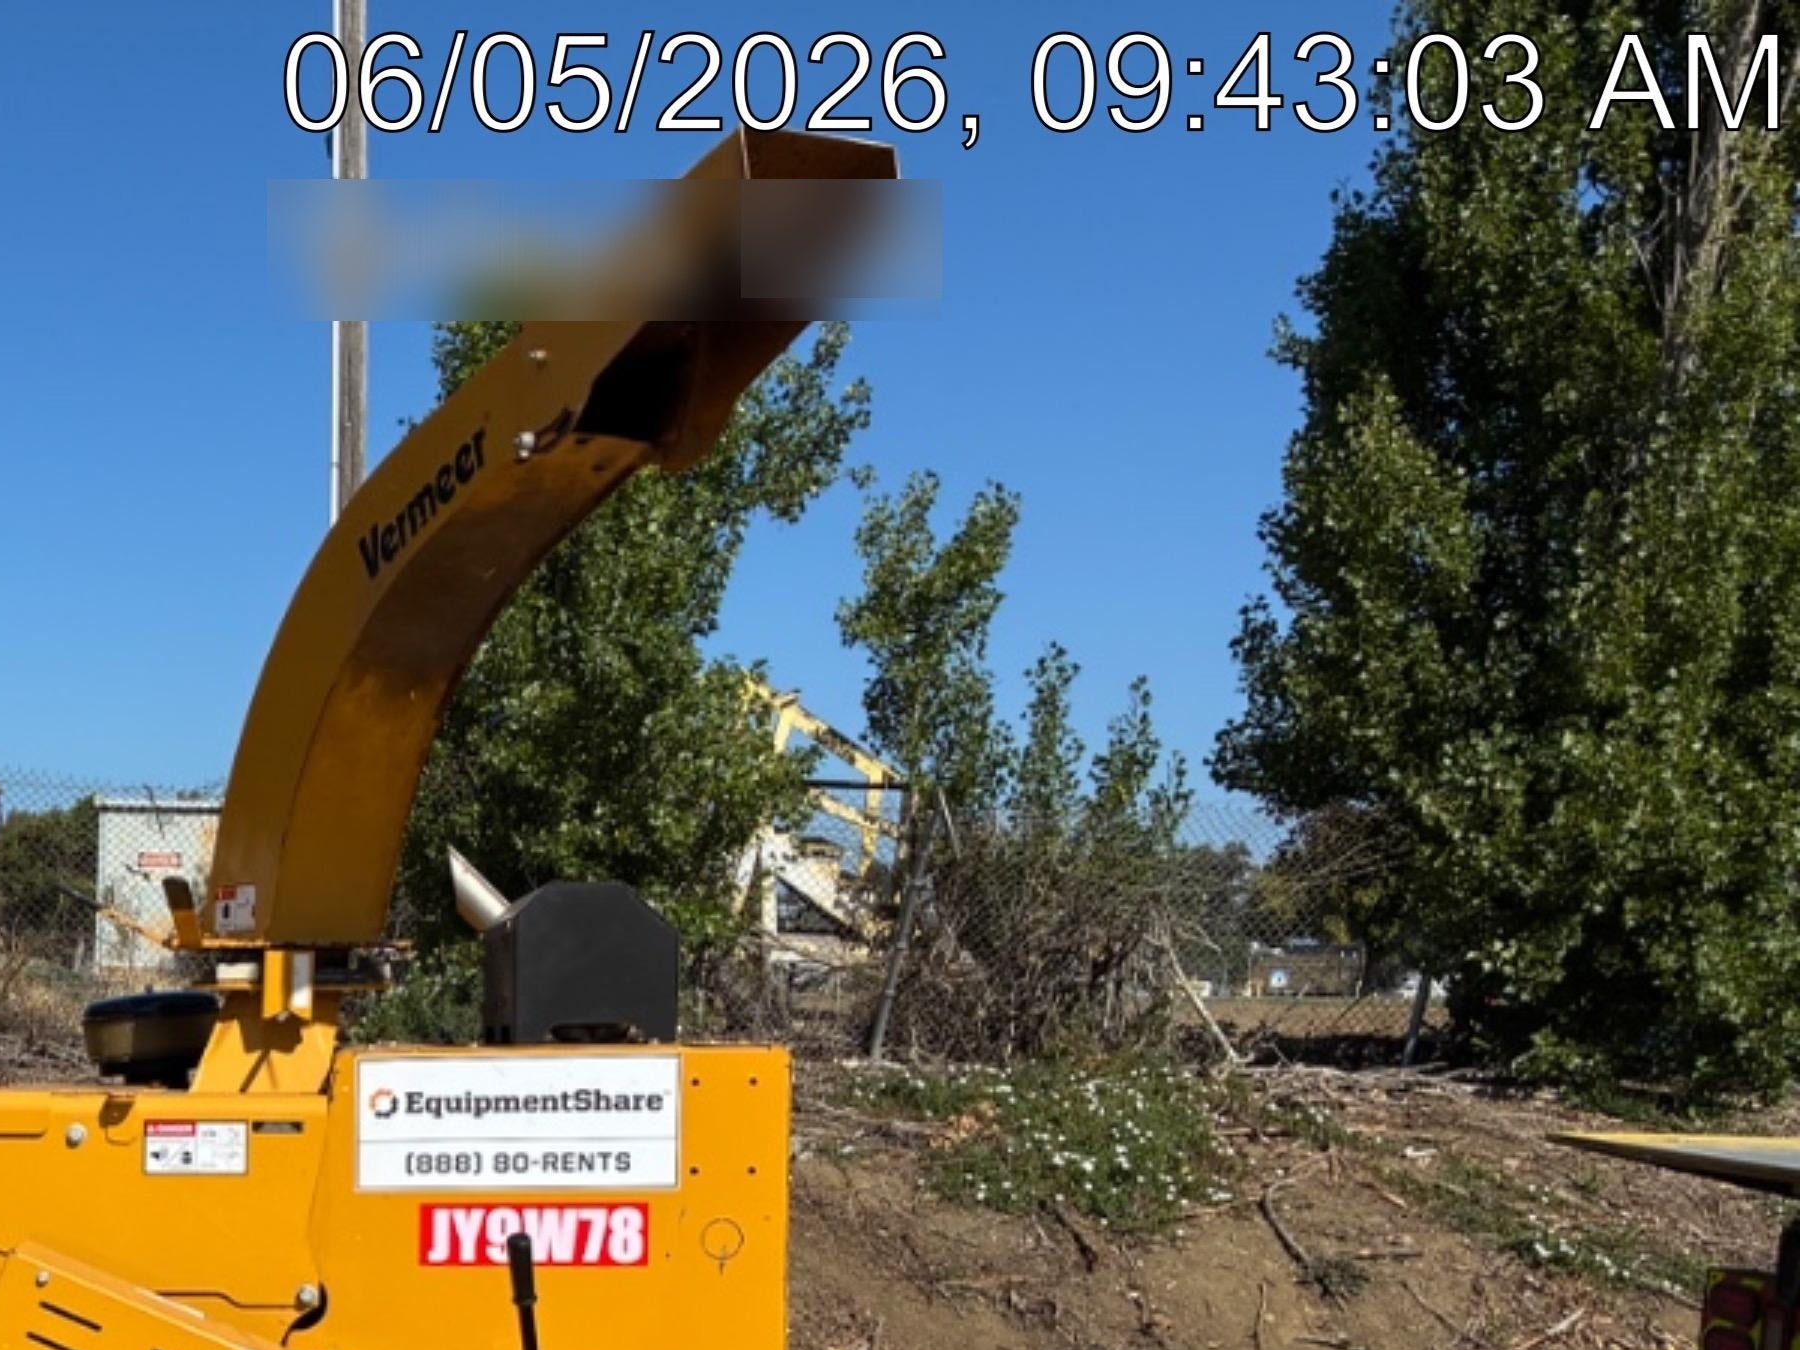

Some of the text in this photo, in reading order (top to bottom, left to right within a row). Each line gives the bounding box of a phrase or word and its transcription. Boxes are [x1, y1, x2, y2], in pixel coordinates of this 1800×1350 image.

[358, 427, 487, 579] Vermeer
[404, 1088, 664, 1118] EquipmentShare
[405, 1151, 632, 1175] (888) 80-RENTS
[426, 1206, 645, 1265] JY9W78
